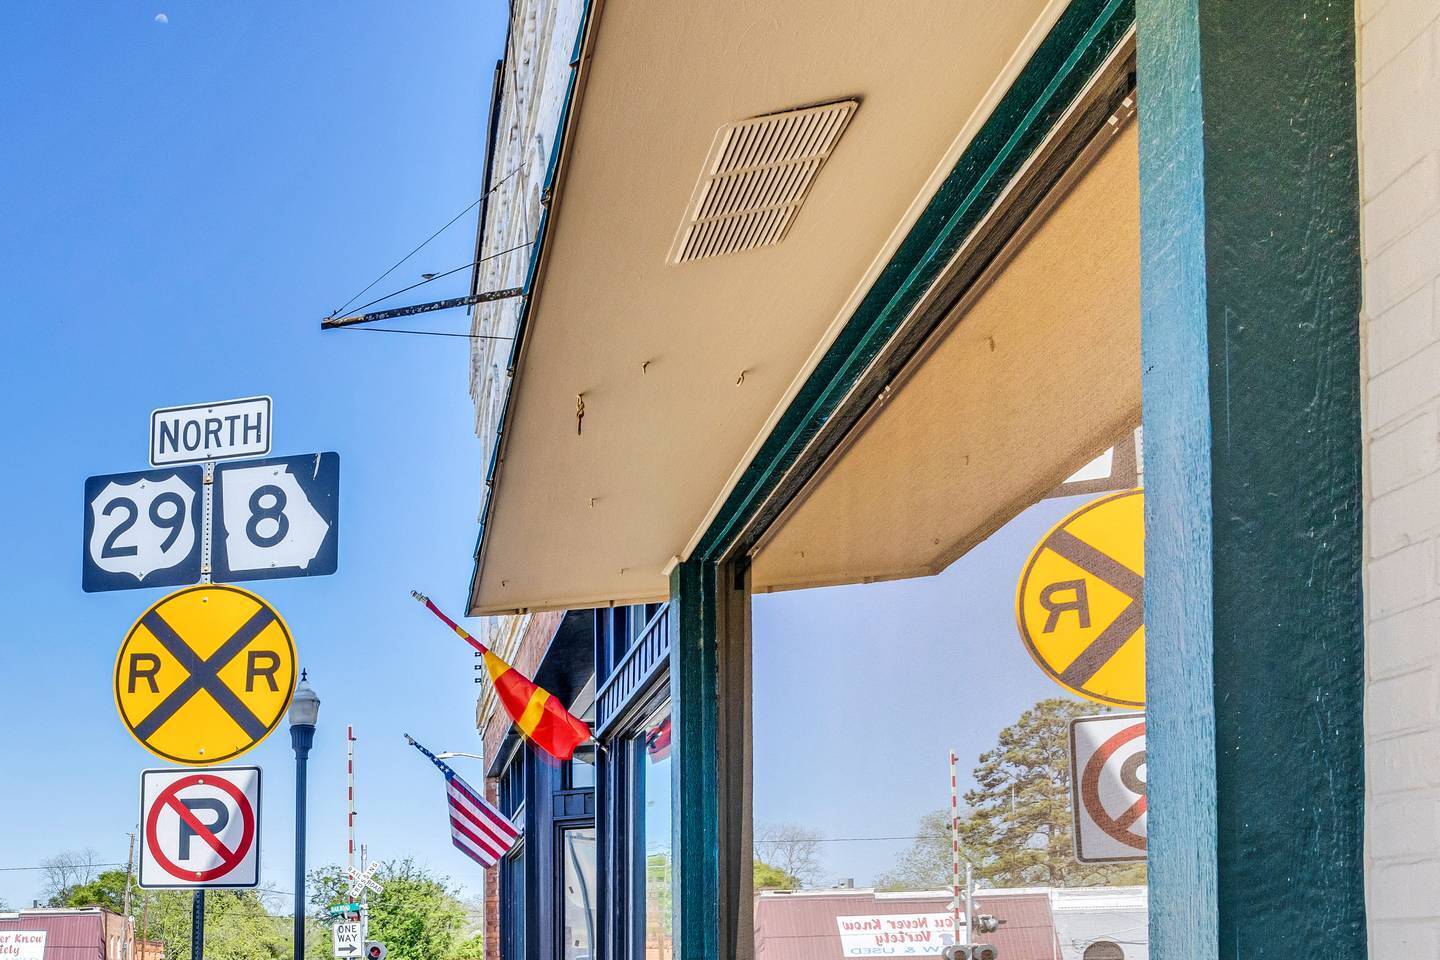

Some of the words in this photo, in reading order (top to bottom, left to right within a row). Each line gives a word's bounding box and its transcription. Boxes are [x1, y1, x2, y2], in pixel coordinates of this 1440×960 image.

[158, 412, 263, 455] NORTH
[101, 491, 187, 559] 29
[246, 484, 290, 548] 8
[127, 652, 162, 694] R
[245, 650, 280, 692] R
[179, 798, 229, 860] P
[14, 934, 44, 943] Know
[337, 934, 358, 943] WAY
[338, 925, 357, 933] ONE
